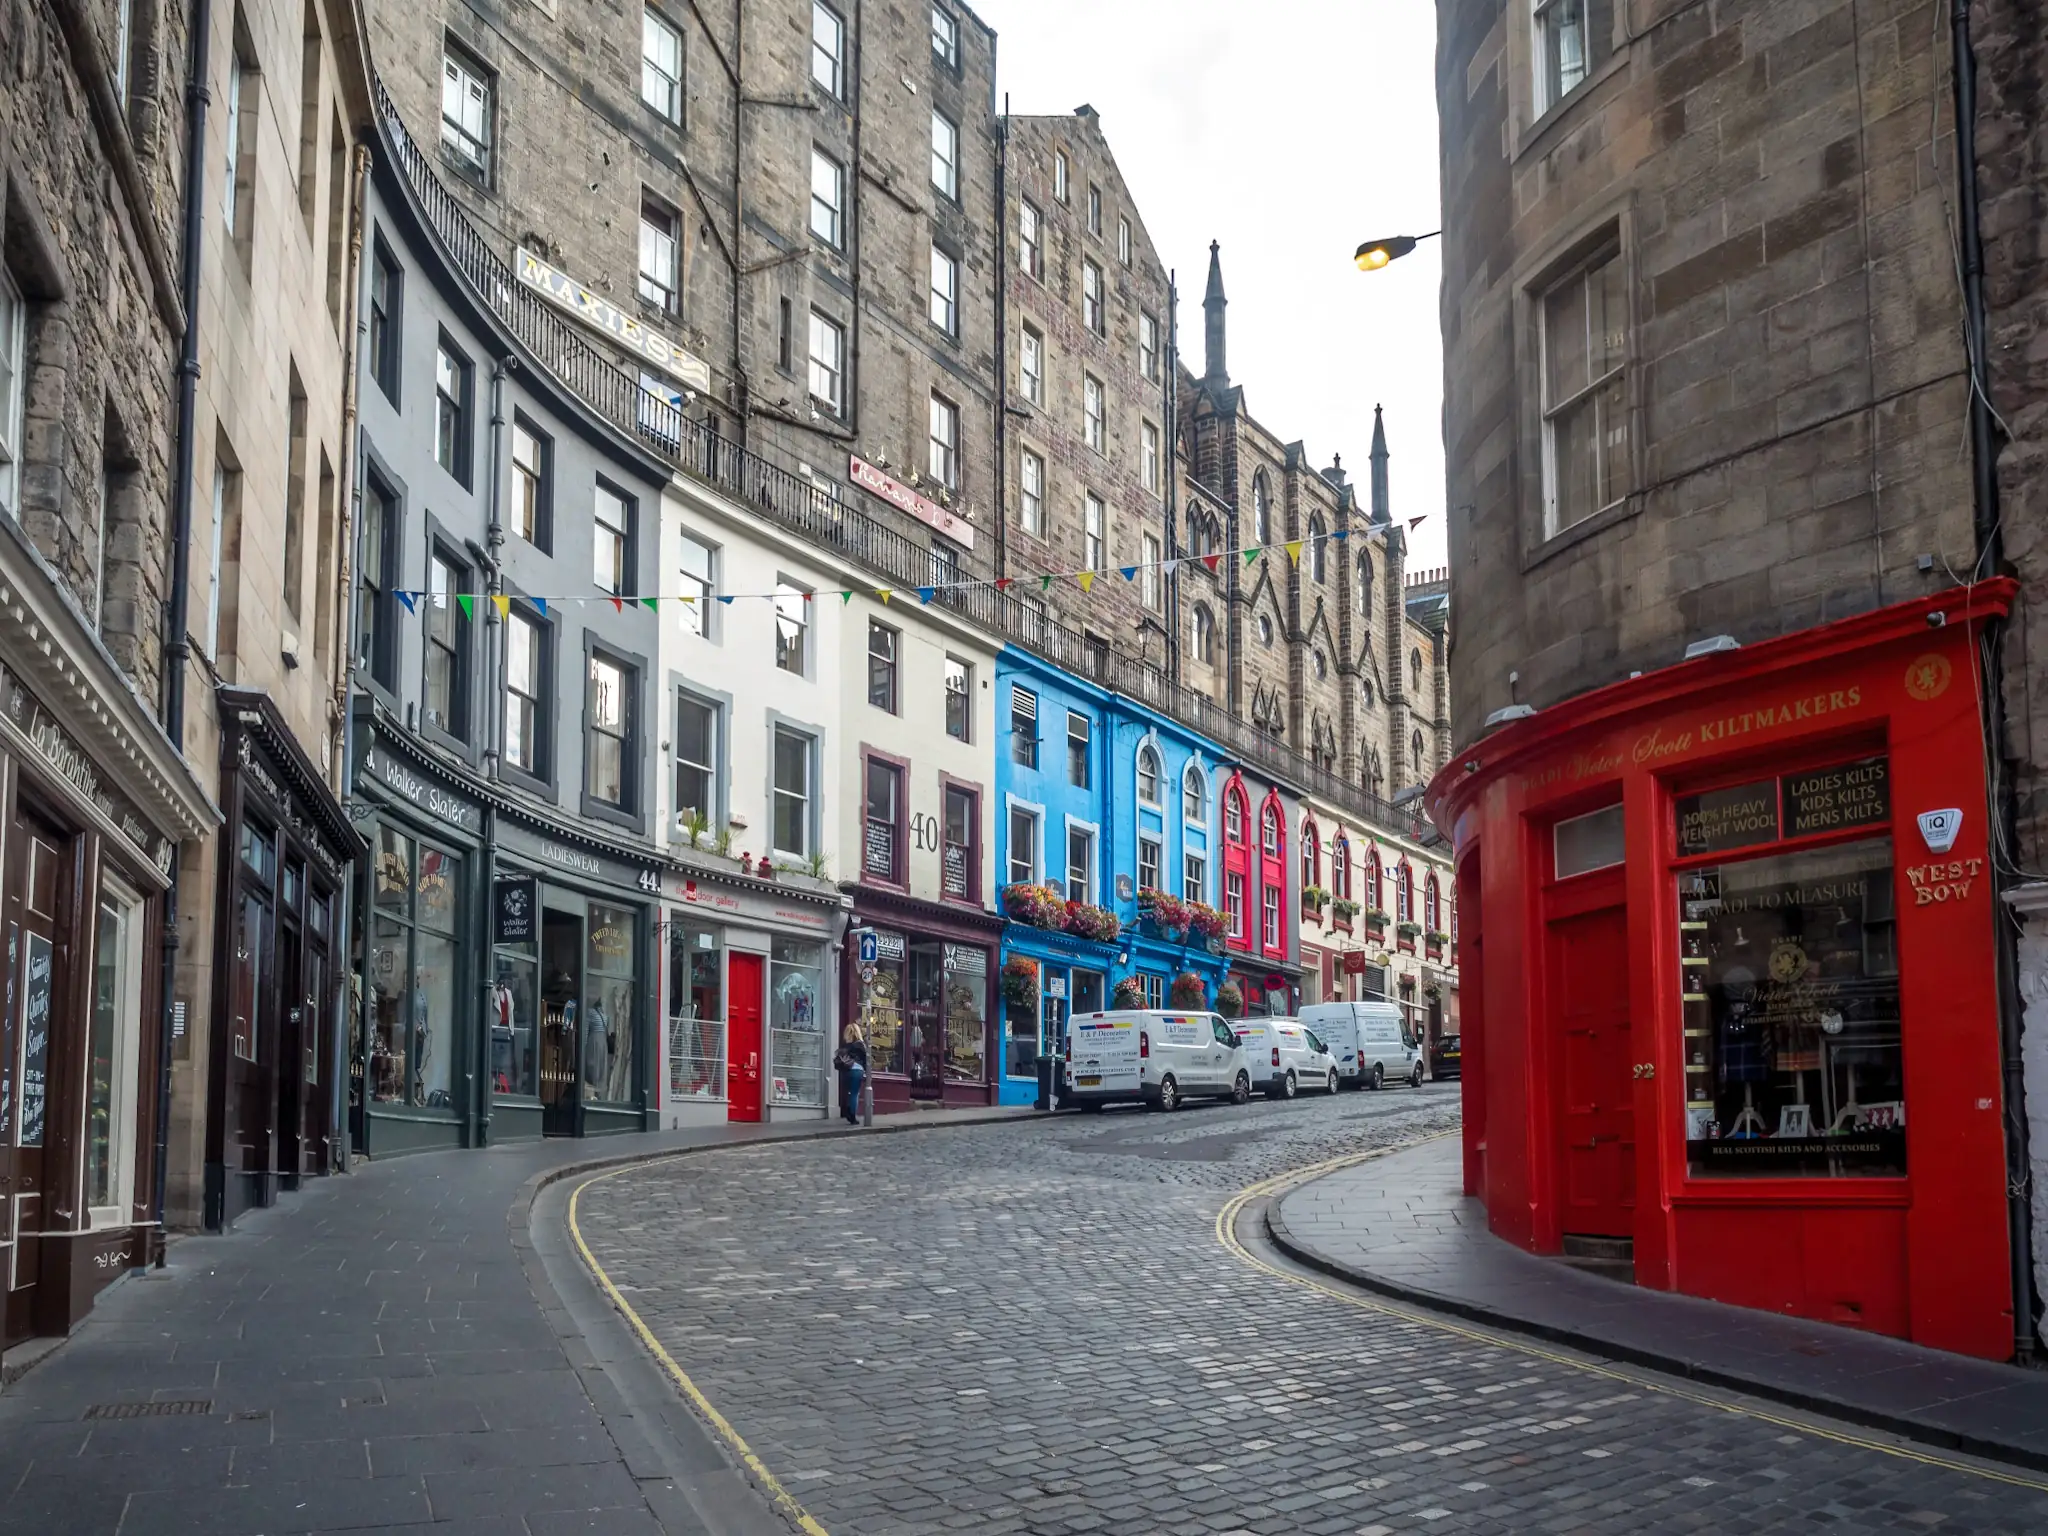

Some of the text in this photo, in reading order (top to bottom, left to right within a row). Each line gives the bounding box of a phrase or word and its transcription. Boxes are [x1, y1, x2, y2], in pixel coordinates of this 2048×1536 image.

[522, 257, 670, 363] MAXIES
[29, 704, 46, 751] La
[1566, 746, 1623, 782] Victor
[1632, 728, 1692, 765] Scott
[1701, 685, 1861, 743] KILTMAKERS
[386, 760, 423, 801] Walker
[429, 788, 466, 824] Slater
[1792, 765, 1884, 796] LADIES KILTS
[1684, 797, 1768, 827] 100% HEAVY
[1801, 785, 1877, 812] KIDS KILTS
[1677, 814, 1776, 844] WEIGHT WOOL
[1796, 801, 1883, 830] MENS KILTS
[910, 812, 938, 852] 40
[156, 837, 173, 876] 89
[541, 842, 600, 875] LADIESWEAR
[1906, 858, 1982, 887] WEST
[697, 888, 713, 902] door
[716, 895, 740, 910] gallery
[1758, 893, 1781, 909] TO
[1785, 880, 1868, 905] MEASURE
[1915, 879, 1972, 905] BOW
[503, 917, 529, 927] Walker
[503, 926, 529, 937] Slater
[1098, 1029, 1131, 1037] Decorators
[1632, 1063, 1655, 1080] 92
[1713, 1146, 1733, 1155] REAL
[1735, 1145, 1776, 1155] SCOTTISH
[1778, 1145, 1802, 1154] KILTS
[1804, 1144, 1823, 1153] AND
